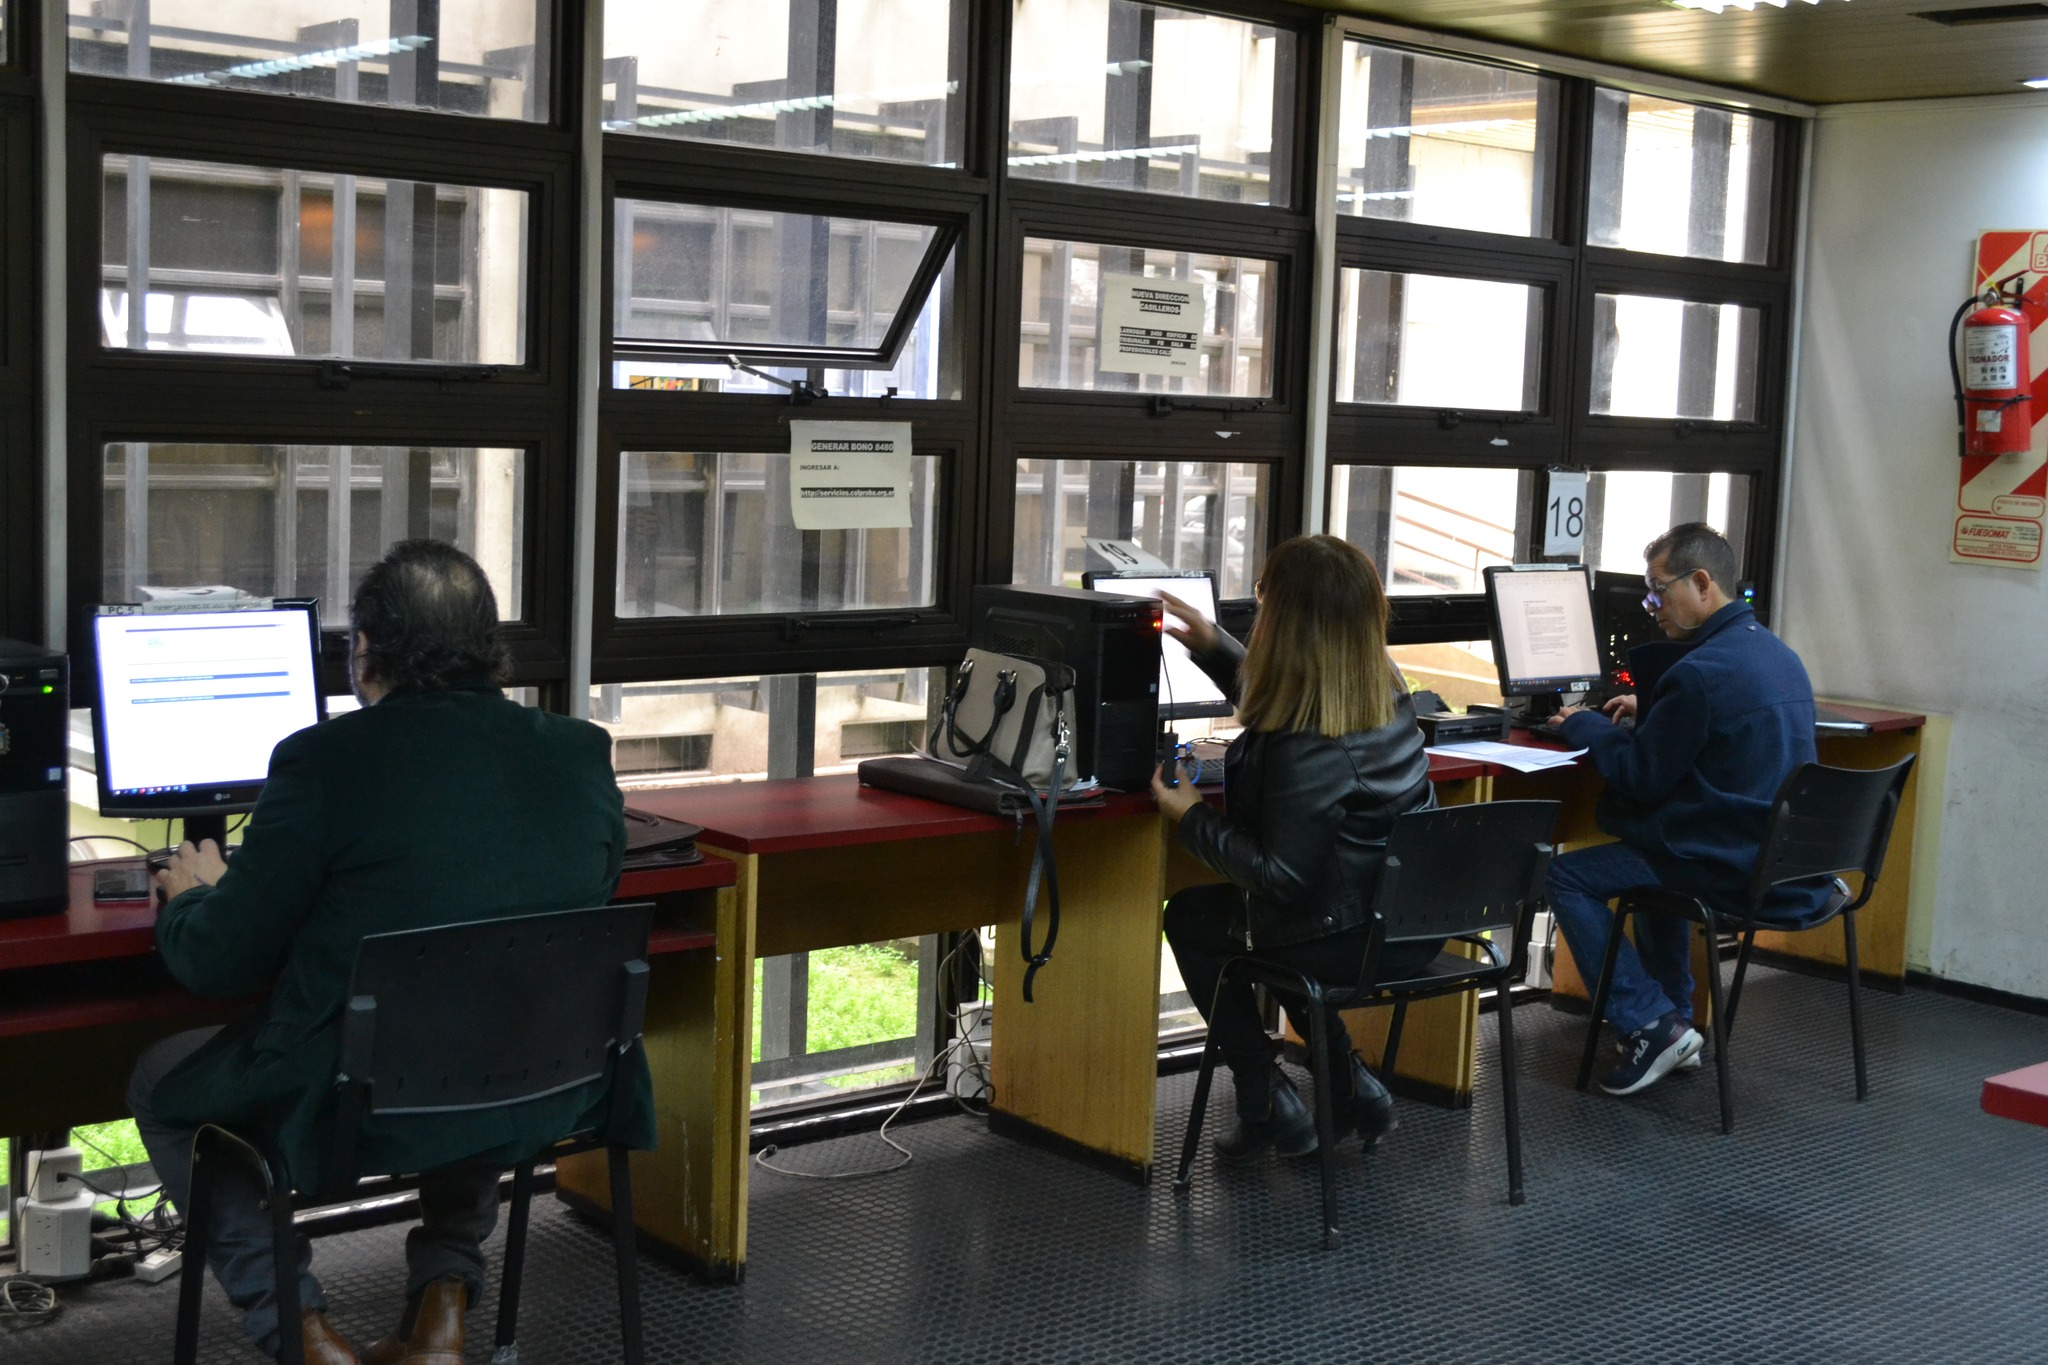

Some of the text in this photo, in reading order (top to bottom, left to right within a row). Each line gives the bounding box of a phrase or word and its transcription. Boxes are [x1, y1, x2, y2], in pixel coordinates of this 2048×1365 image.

[1132, 290, 1190, 303] NUEVA DIRECCION
[1120, 327, 1146, 336] LARROQUE
[1166, 331, 1188, 339] EDIFICIO
[1120, 336, 1150, 345] TRIBUNALES
[1120, 345, 1159, 354] PROFESIONALES
[1968, 354, 2010, 364] TRONADOR
[811, 442, 894, 452] GENERAR BONO 8480
[1550, 496, 1584, 538] 18
[1968, 527, 2011, 539] FUEGOMAT
[108, 605, 135, 615] PC 5
[1632, 1039, 1650, 1065] FILA
